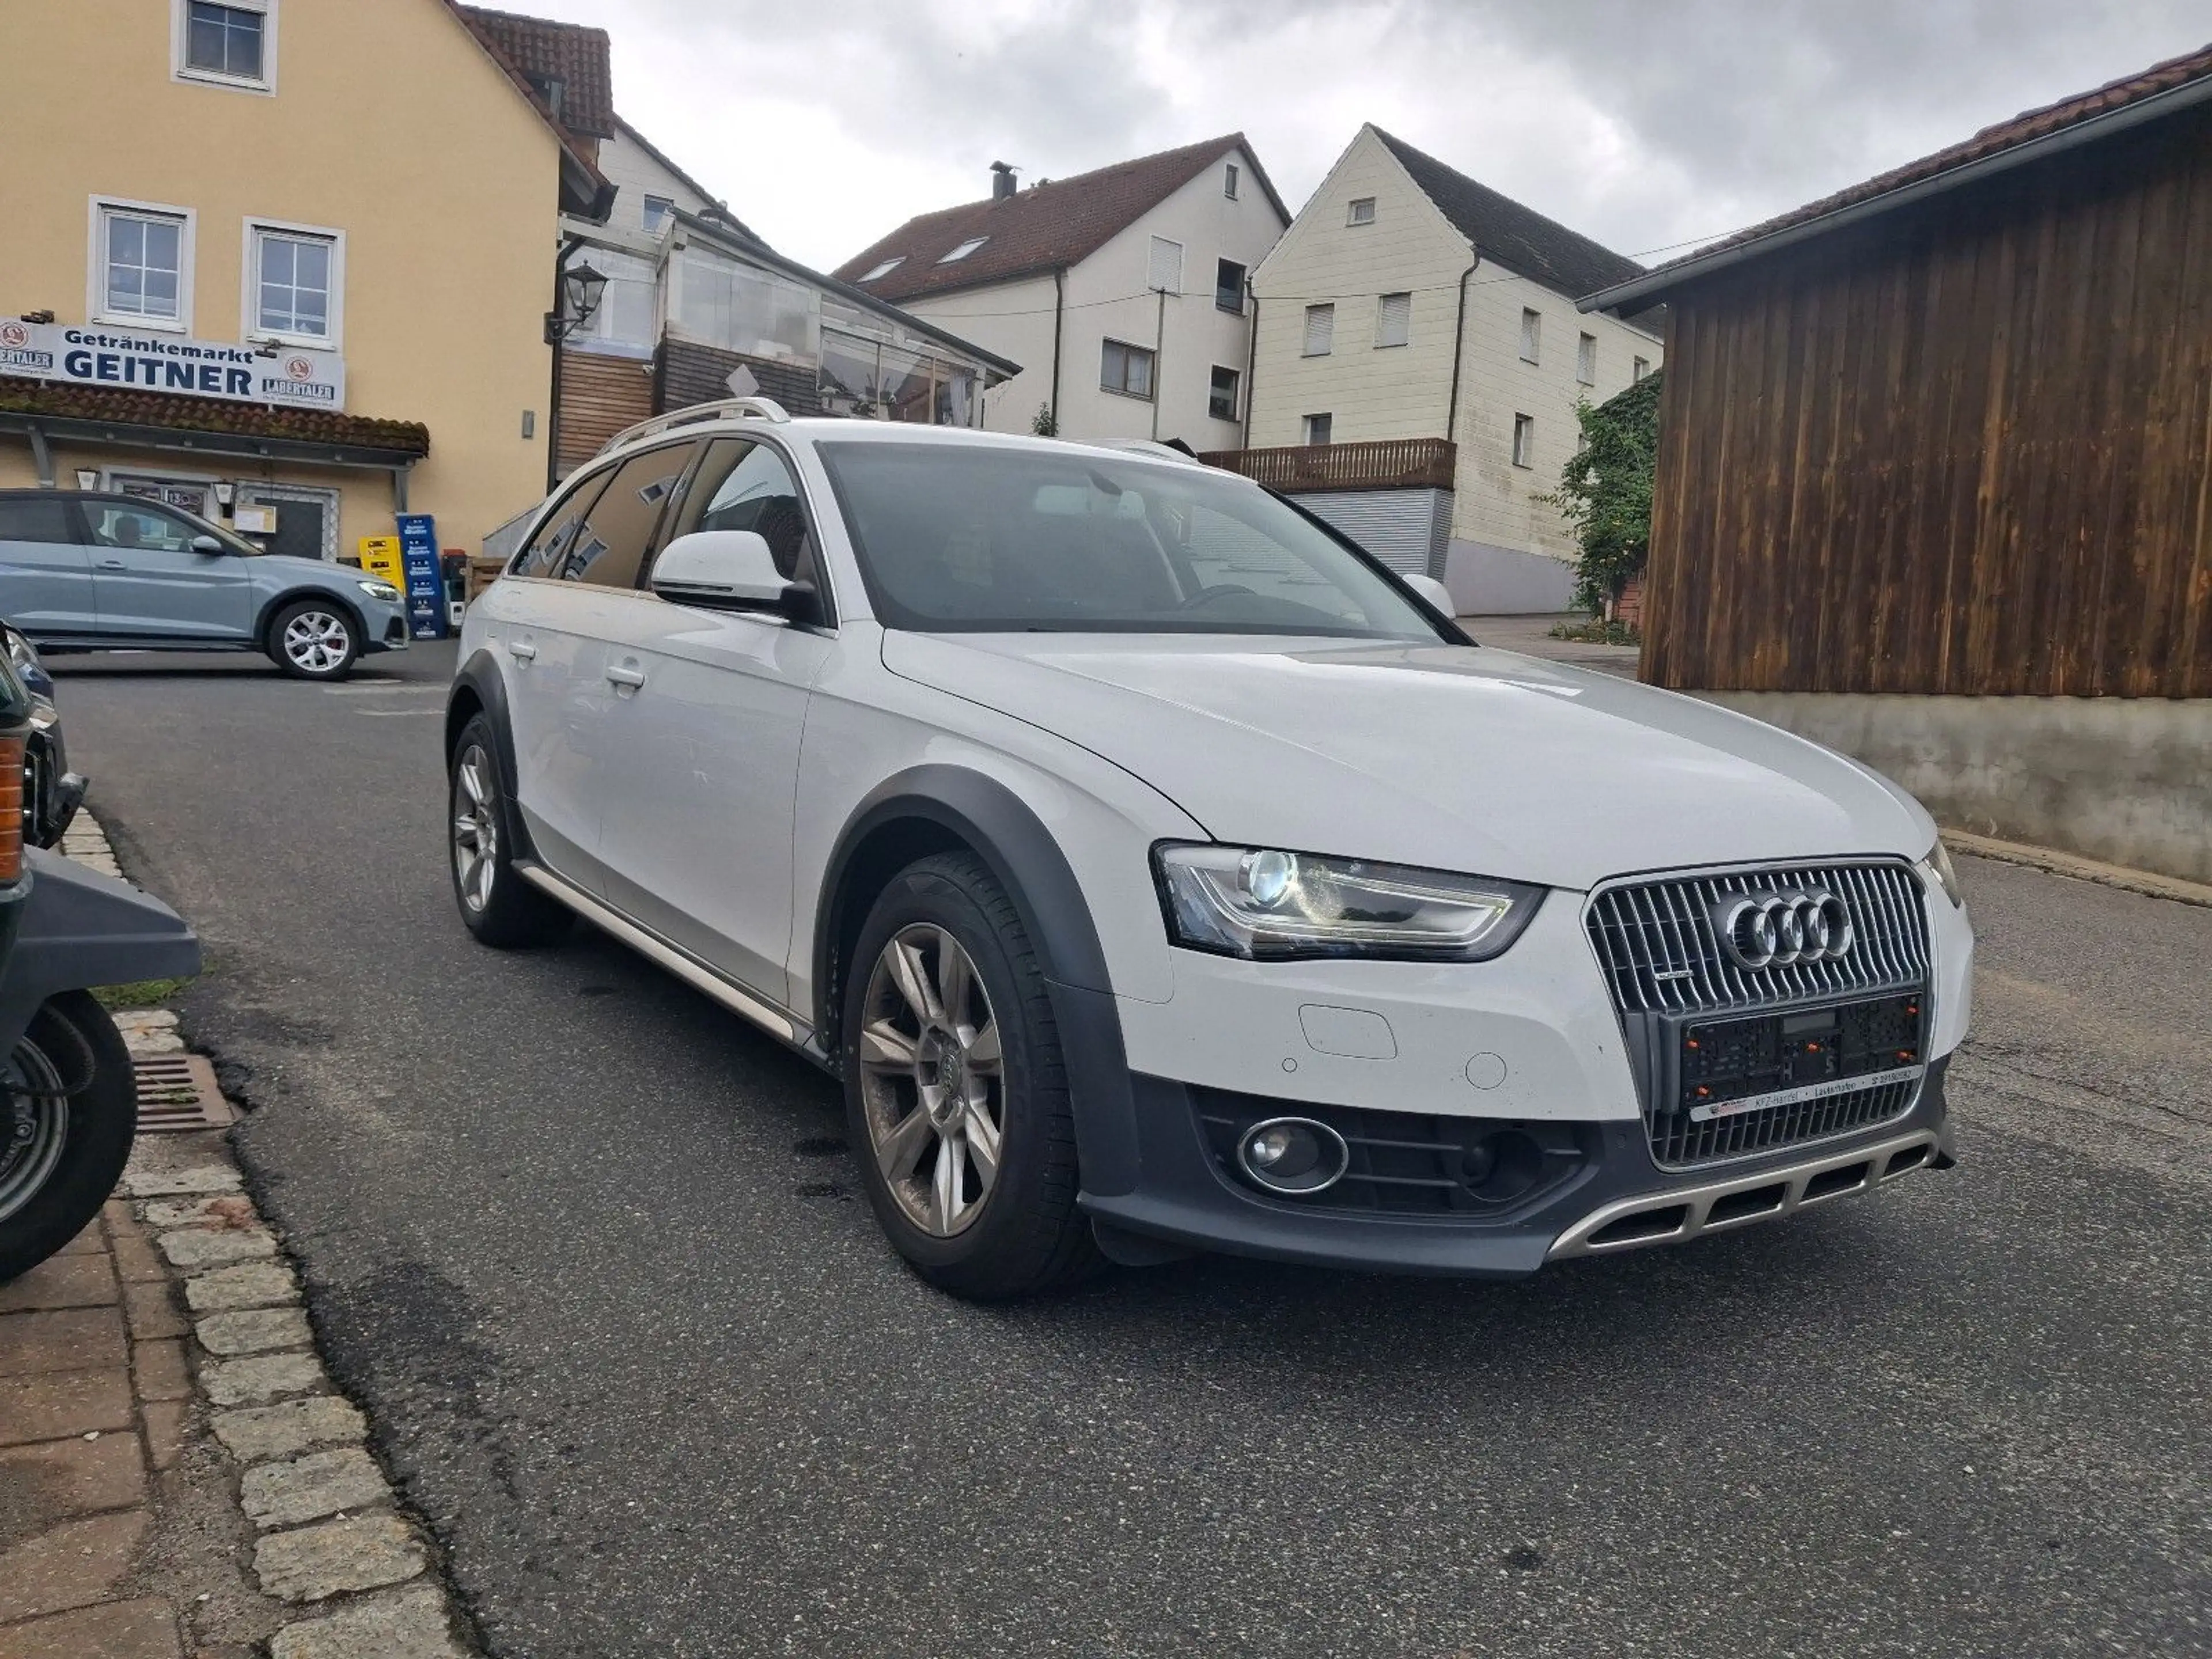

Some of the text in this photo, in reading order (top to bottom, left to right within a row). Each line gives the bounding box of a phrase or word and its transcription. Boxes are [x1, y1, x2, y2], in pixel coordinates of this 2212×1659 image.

[65, 329, 253, 364] Getränkemarkt
[65, 350, 252, 396] GEITNER
[264, 379, 333, 400] LABERTALER
